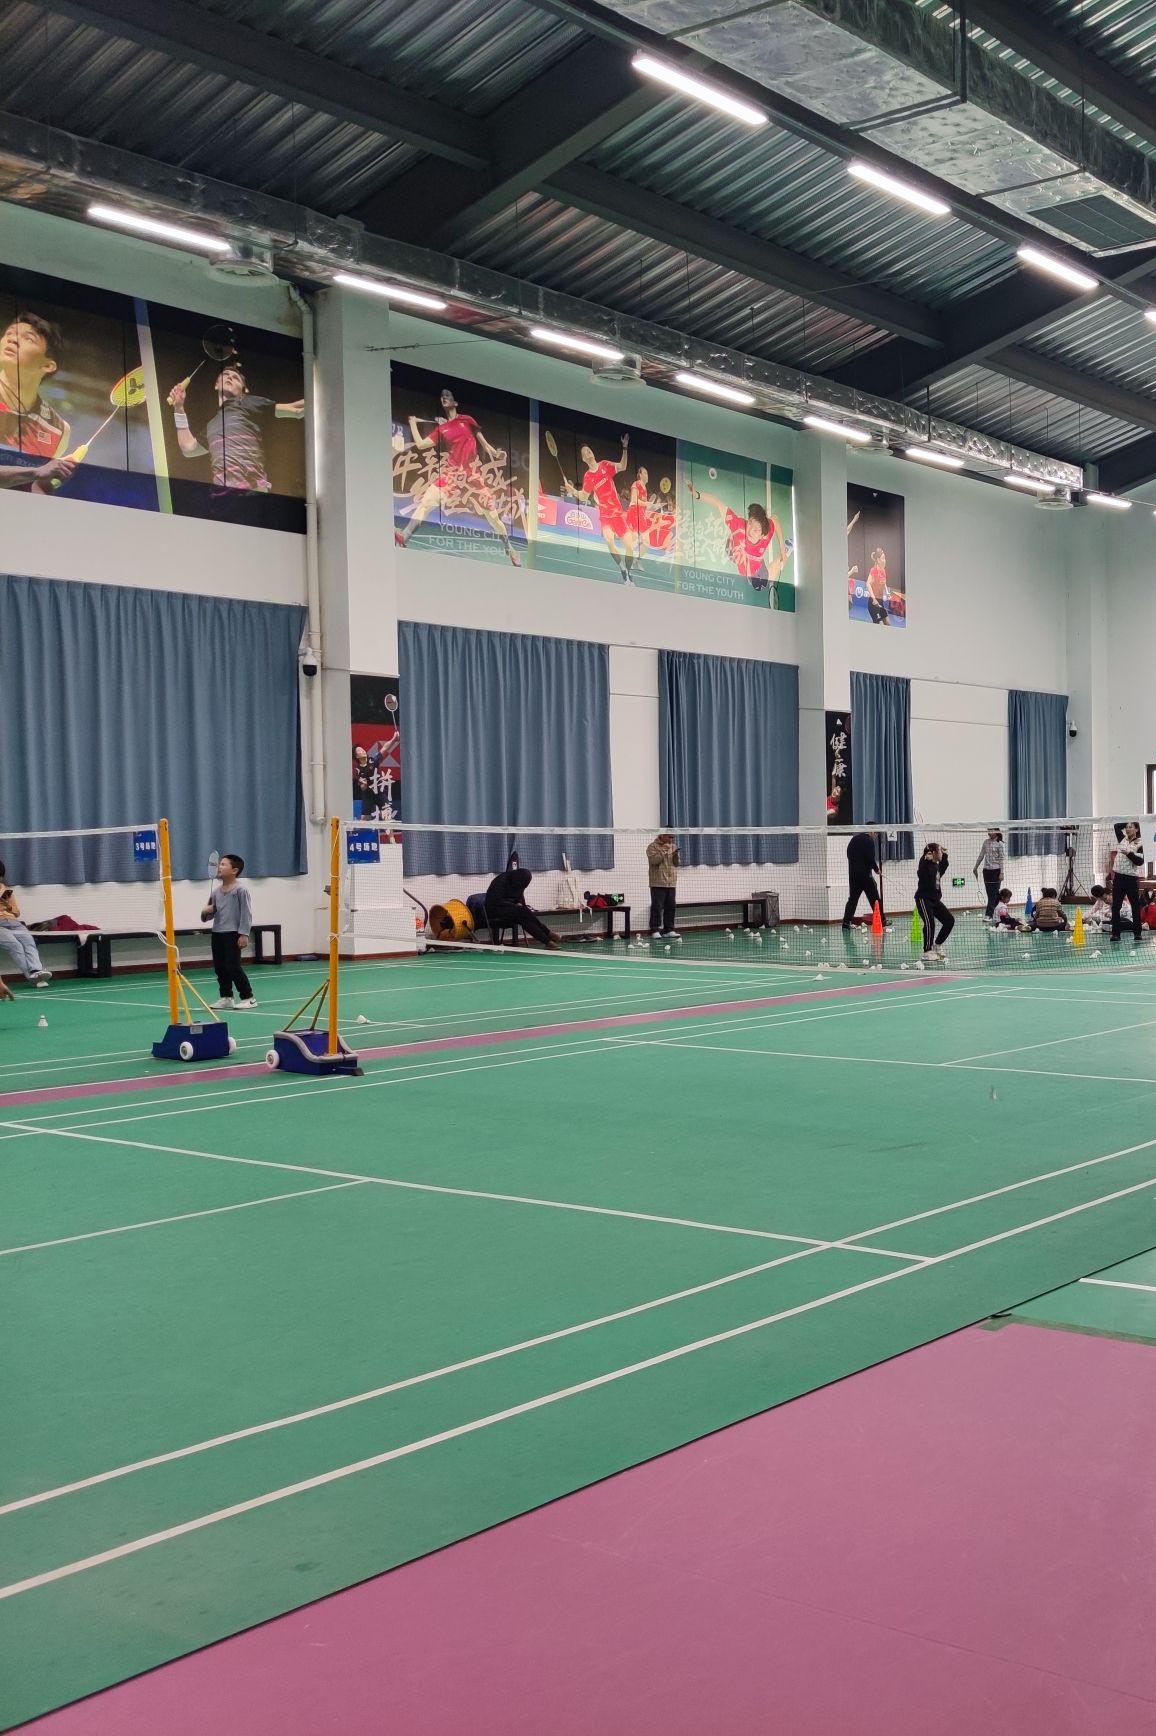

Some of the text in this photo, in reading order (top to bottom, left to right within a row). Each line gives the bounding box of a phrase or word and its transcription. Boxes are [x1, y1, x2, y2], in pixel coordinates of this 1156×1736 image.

[439, 522, 481, 538] YOUNG
[428, 536, 455, 548] FOR
[456, 540, 482, 553] THE
[683, 568, 736, 586] YOUNG CITY
[675, 580, 744, 600] FOR THE YOUTH
